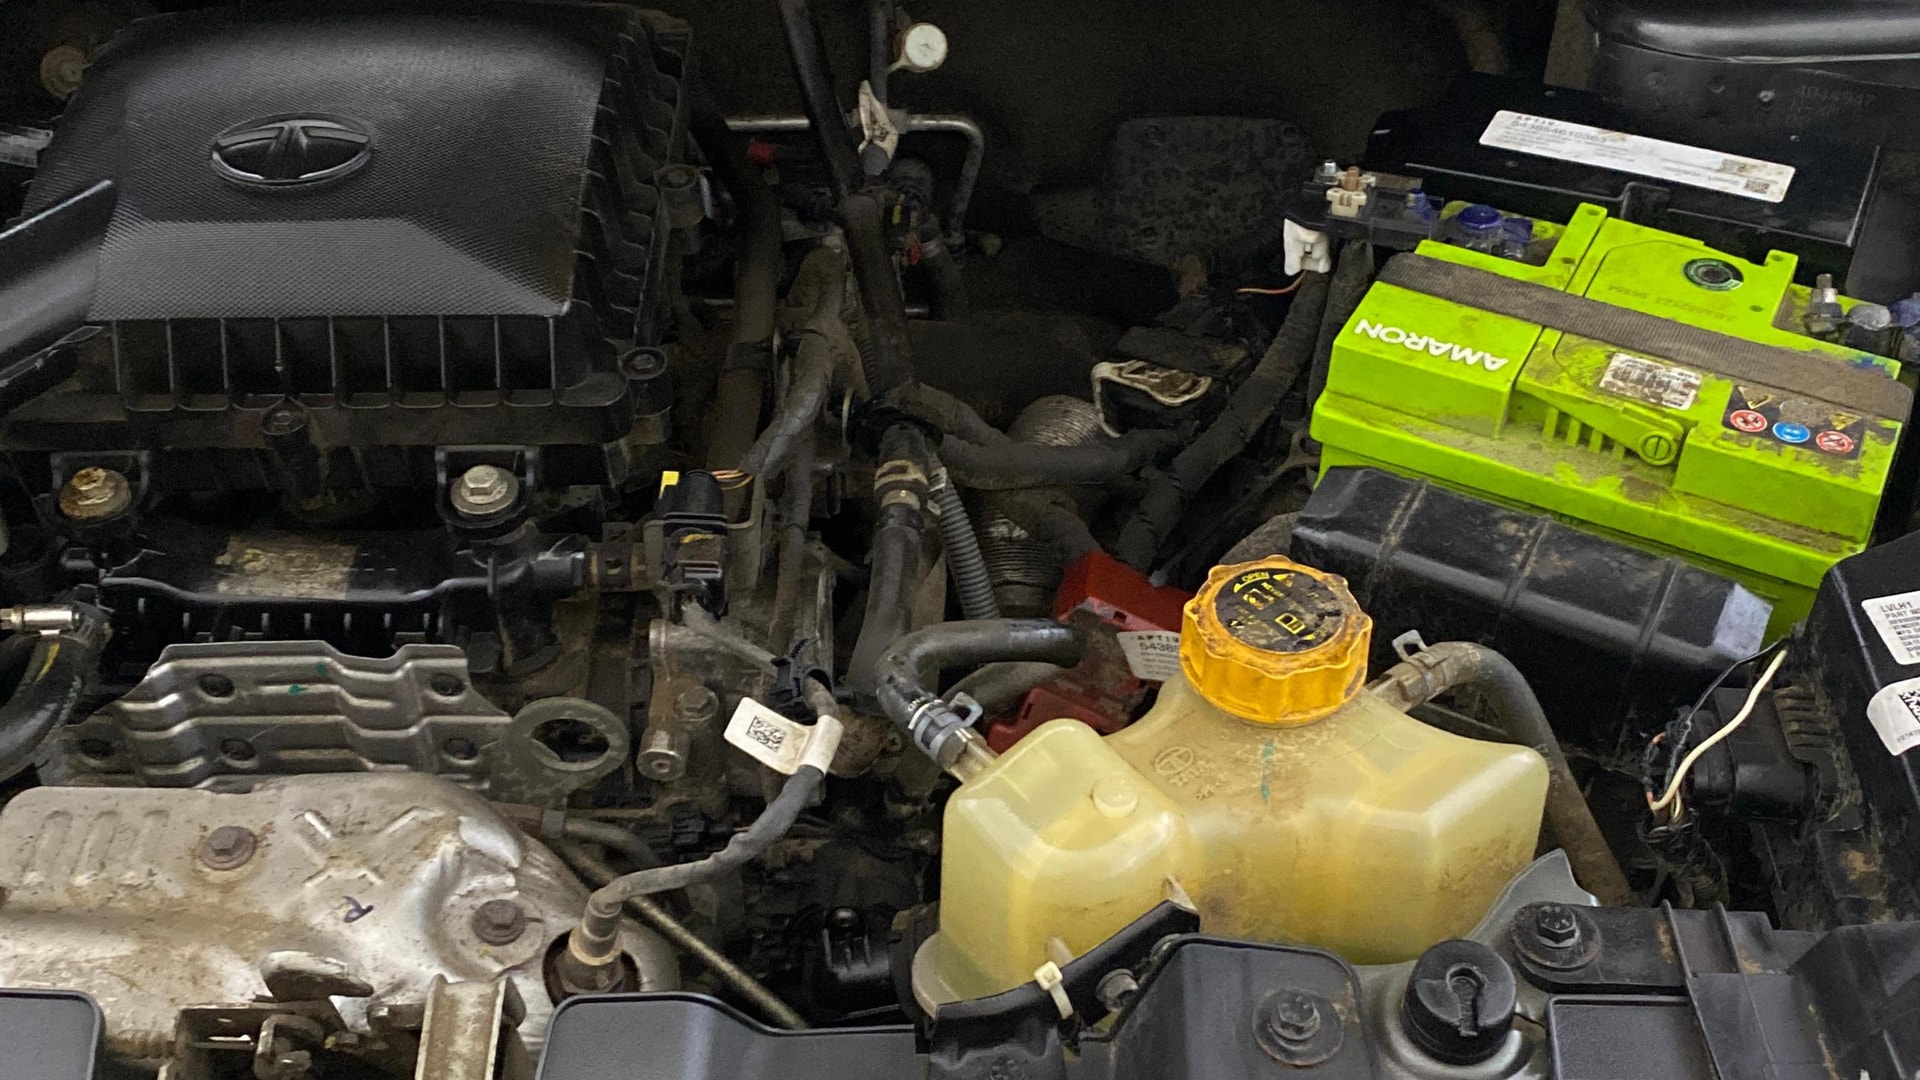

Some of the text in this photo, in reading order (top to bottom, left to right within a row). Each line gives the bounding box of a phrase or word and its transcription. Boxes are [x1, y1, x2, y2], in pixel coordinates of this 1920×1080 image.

[1355, 318, 1509, 372] AMARON
[1241, 571, 1270, 583] OPEN
[1880, 602, 1913, 613] LVLH1
[1884, 610, 1909, 619] PART
[1137, 634, 1179, 643] APTIV
